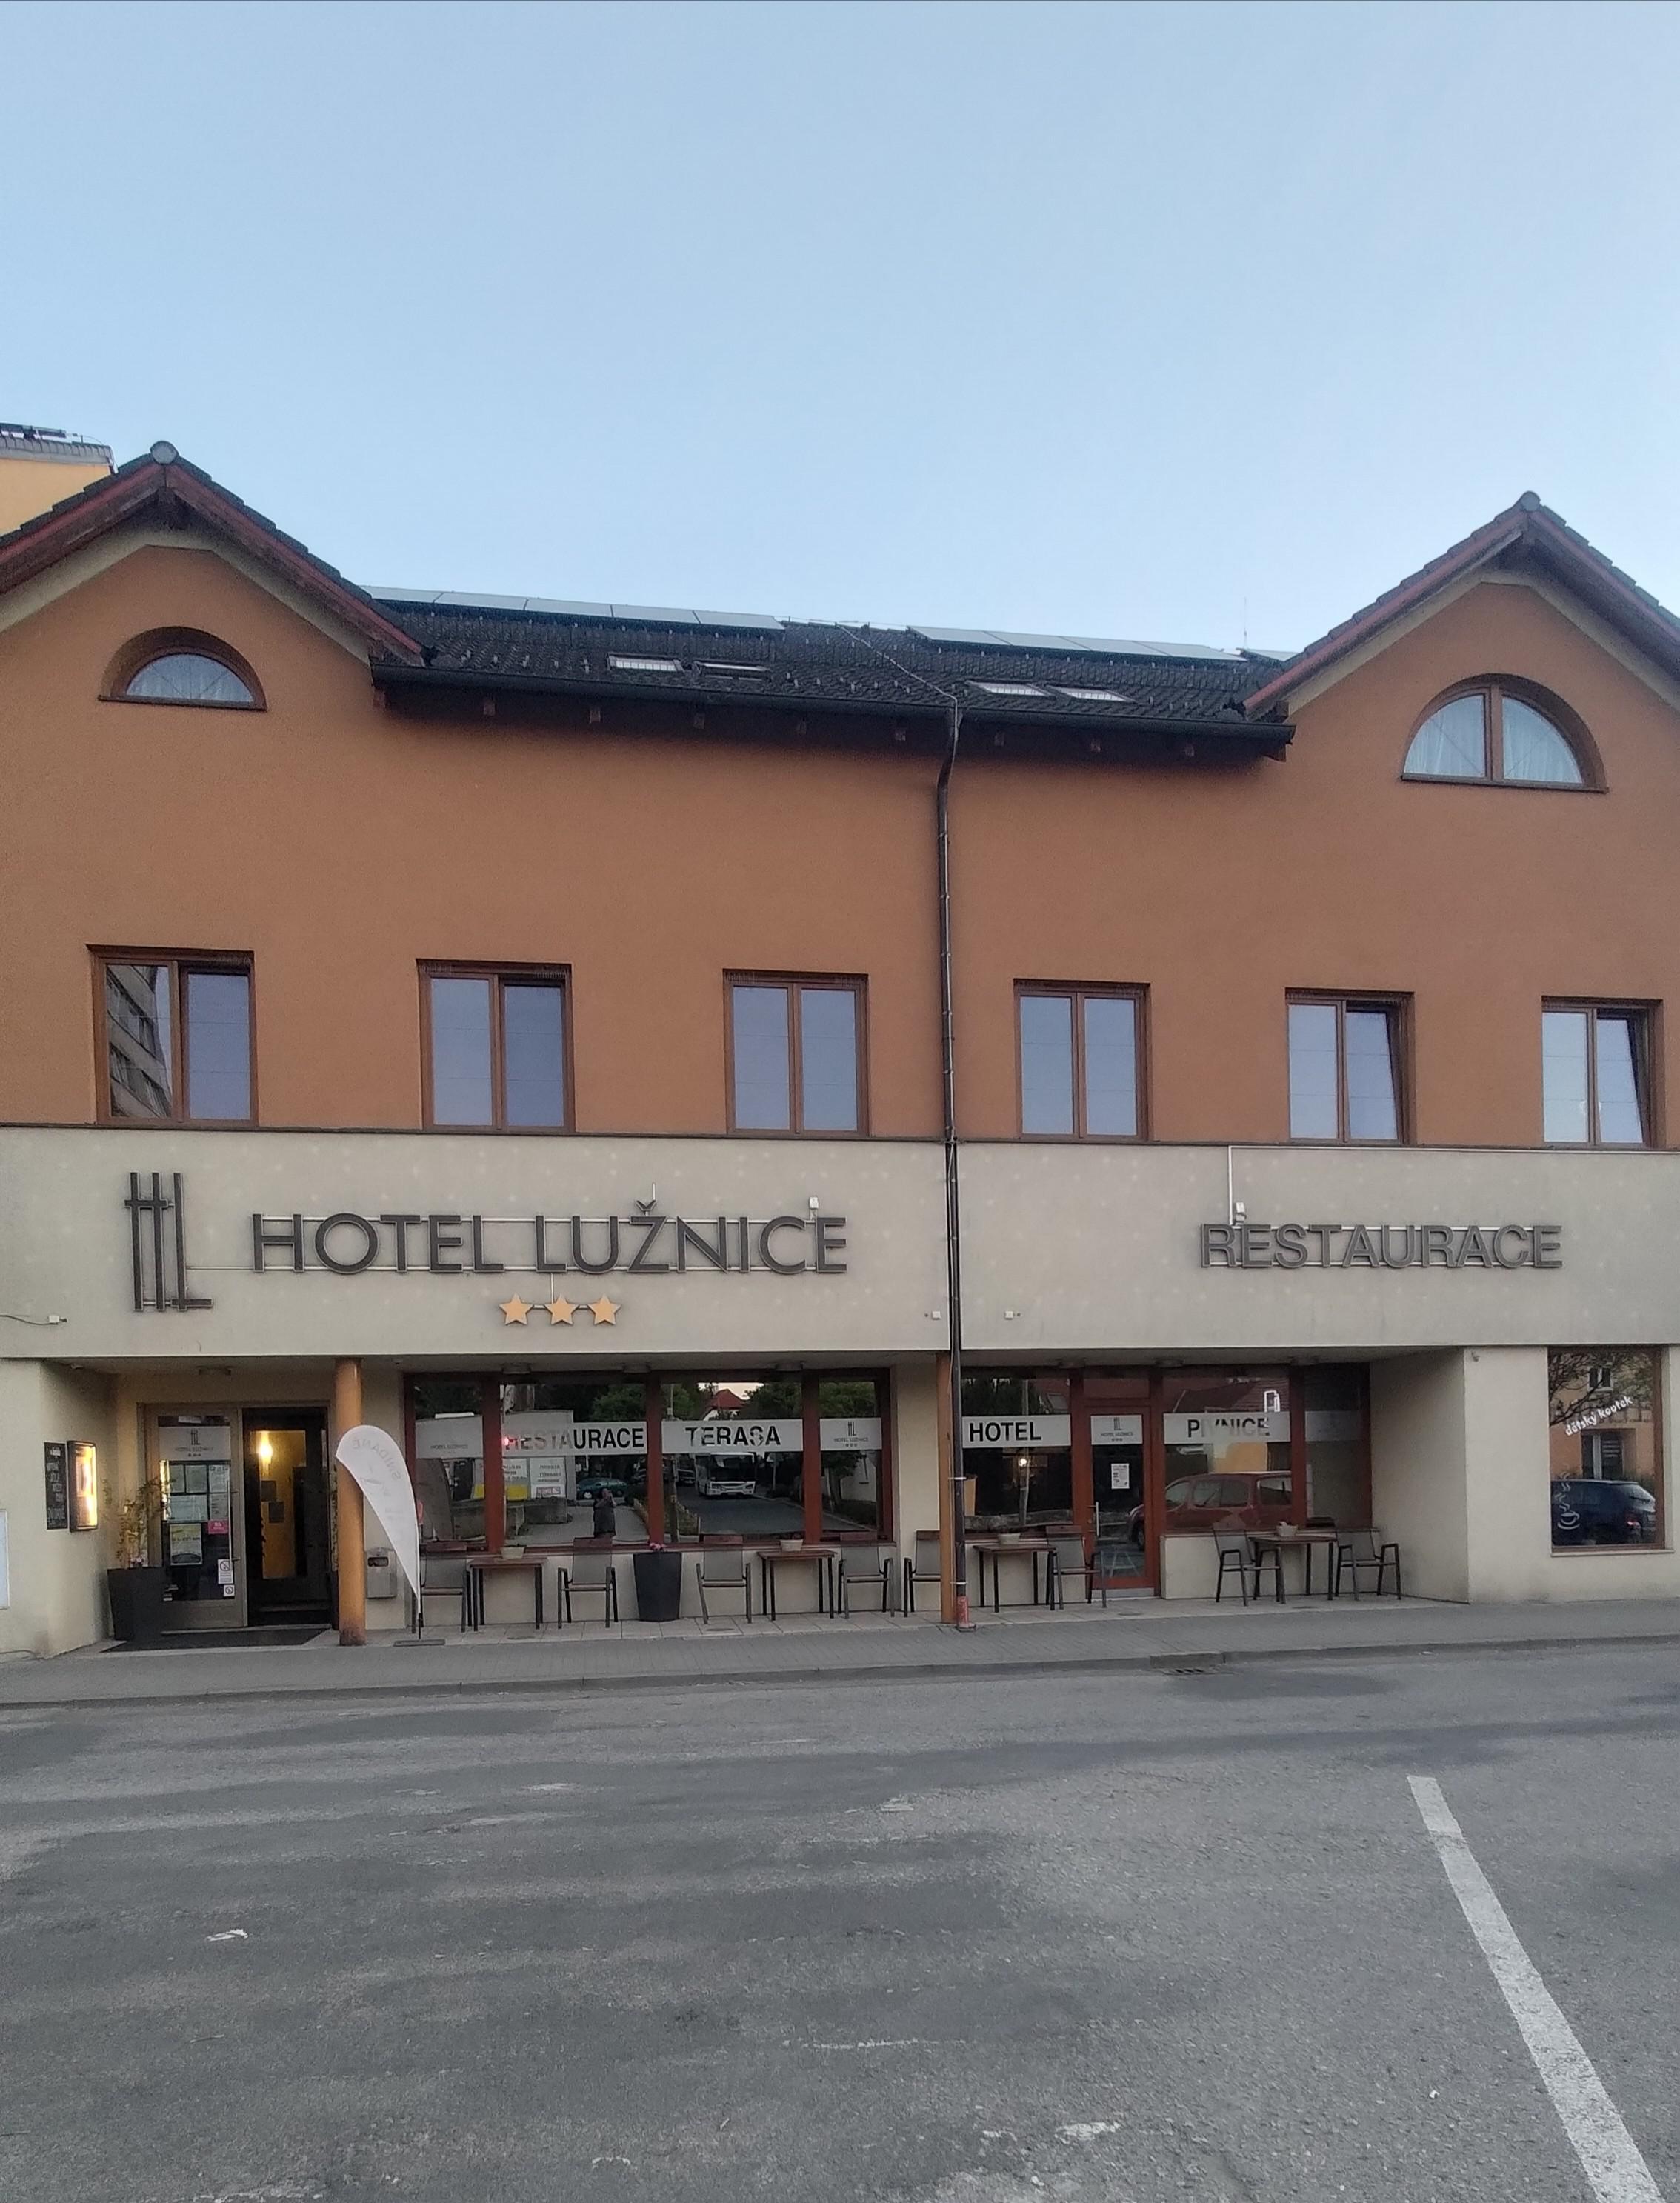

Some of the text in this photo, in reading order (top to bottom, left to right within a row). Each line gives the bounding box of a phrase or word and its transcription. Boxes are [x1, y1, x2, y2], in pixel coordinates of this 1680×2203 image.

[252, 1199, 848, 1275] HOTEL LUŽNICE
[1200, 1222, 1563, 1269] RESTAURACE
[685, 1425, 781, 1447] TERASA
[969, 1422, 1042, 1442] HOTEL
[1565, 1396, 1633, 1436] dětský koutek
